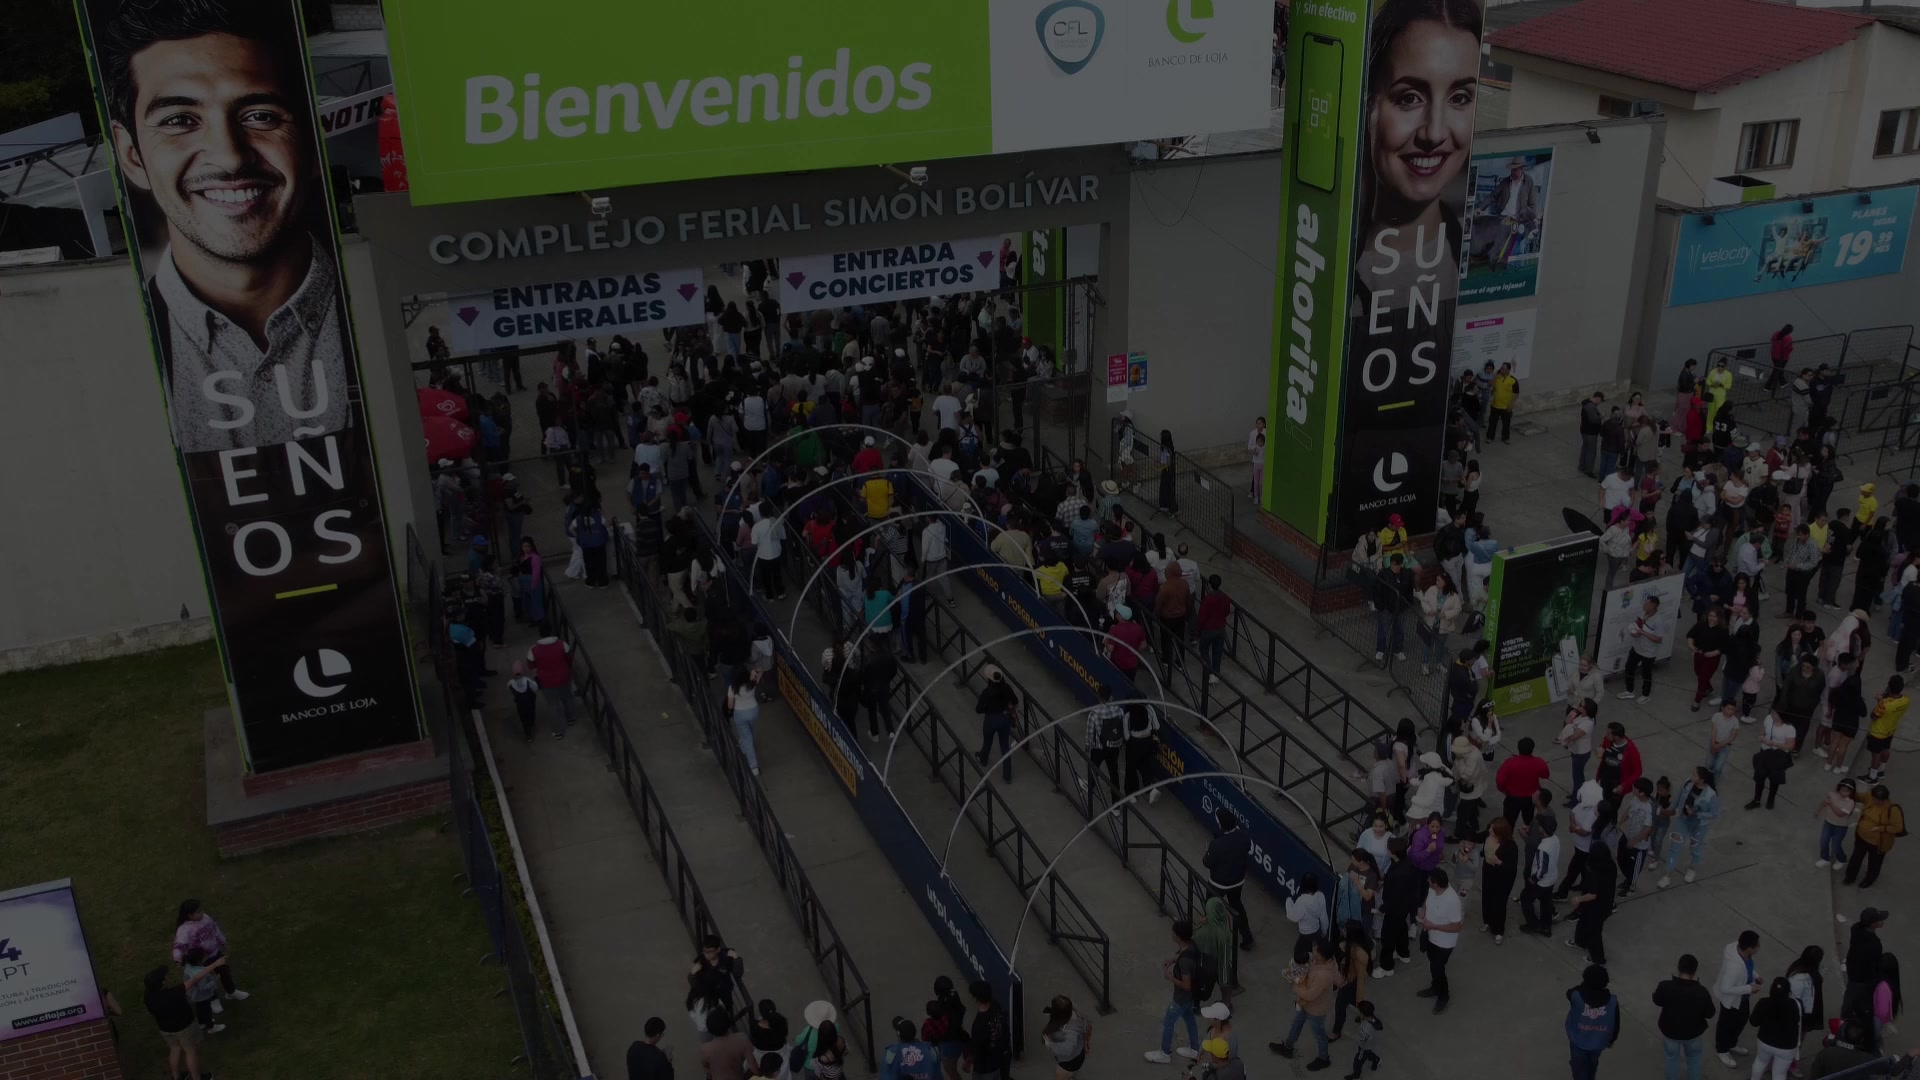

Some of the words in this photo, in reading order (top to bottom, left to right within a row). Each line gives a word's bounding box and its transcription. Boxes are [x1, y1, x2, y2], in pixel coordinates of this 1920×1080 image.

[1296, 1, 1301, 16] y
[1304, 1, 1317, 16] sin
[1319, 2, 1356, 24] efectivo
[1054, 21, 1088, 36] CFL
[1148, 55, 1186, 67] BANCO
[1190, 54, 1202, 63] DE
[1205, 52, 1228, 63] LOJA
[464, 47, 932, 145] Bienvenidos
[429, 214, 666, 266] COMPLEJO
[679, 202, 811, 243] FERIAL
[823, 183, 944, 227] SIMÓN
[956, 170, 1099, 215] BOLÍVAR
[1852, 206, 1888, 219] PLANES
[833, 241, 955, 274] ENTRADA
[1702, 246, 1752, 264] velocity
[494, 272, 662, 311] ENTRADAS
[809, 263, 974, 301] CONCIERTOS
[492, 300, 666, 339] GENERALES
[1286, 203, 1325, 425] ahorita
[1714, 422, 1728, 432] 23
[1359, 498, 1386, 512] BANCO
[1388, 497, 1398, 506] DE
[1400, 493, 1416, 503] LOJA
[976, 567, 999, 592] GRADO
[1008, 595, 1046, 640] POSGRADO
[282, 705, 327, 723] BANCO
[330, 702, 346, 714] DE
[348, 697, 378, 712] LOJA
[1204, 779, 1250, 828] ESCRÍBENOS
[1276, 865, 1300, 896] 54
[926, 883, 986, 982] utpl.edu.ec
[0, 962, 30, 982] PT
[0, 991, 24, 1001] TURA
[31, 979, 77, 994] TRADICIÓN
[24, 988, 70, 1002] ARTESANÍA
[14, 1006, 84, 1028] www.cfloja.org
